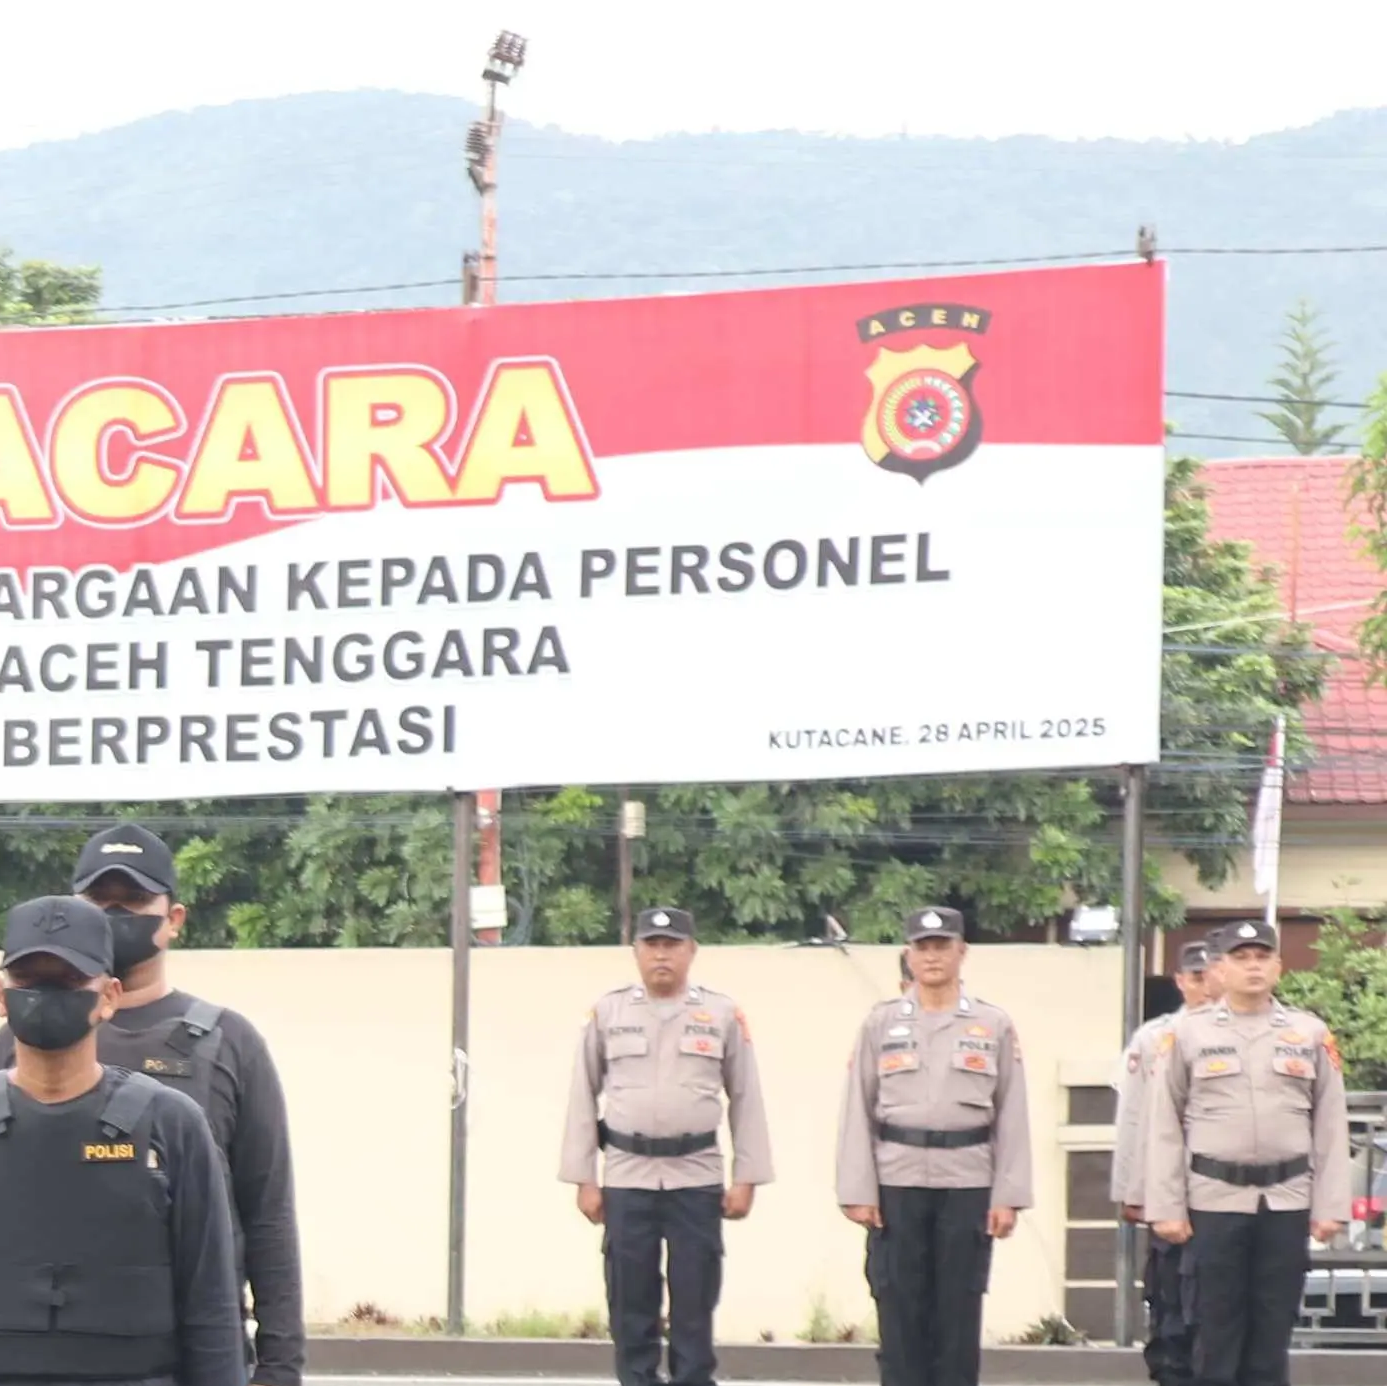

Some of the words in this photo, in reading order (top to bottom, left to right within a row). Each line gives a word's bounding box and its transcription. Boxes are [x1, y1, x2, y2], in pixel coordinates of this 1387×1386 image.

[868, 307, 981, 336] ACEH
[285, 550, 553, 612] KEPADA
[578, 531, 952, 599] PERSONEL
[193, 624, 572, 688] TENGGARA
[1, 704, 456, 767] BERPRESTASI
[918, 722, 949, 744] 28
[957, 720, 1033, 742] APRIL
[1040, 716, 1107, 739] 2025
[84, 1143, 135, 1159] POLISI
